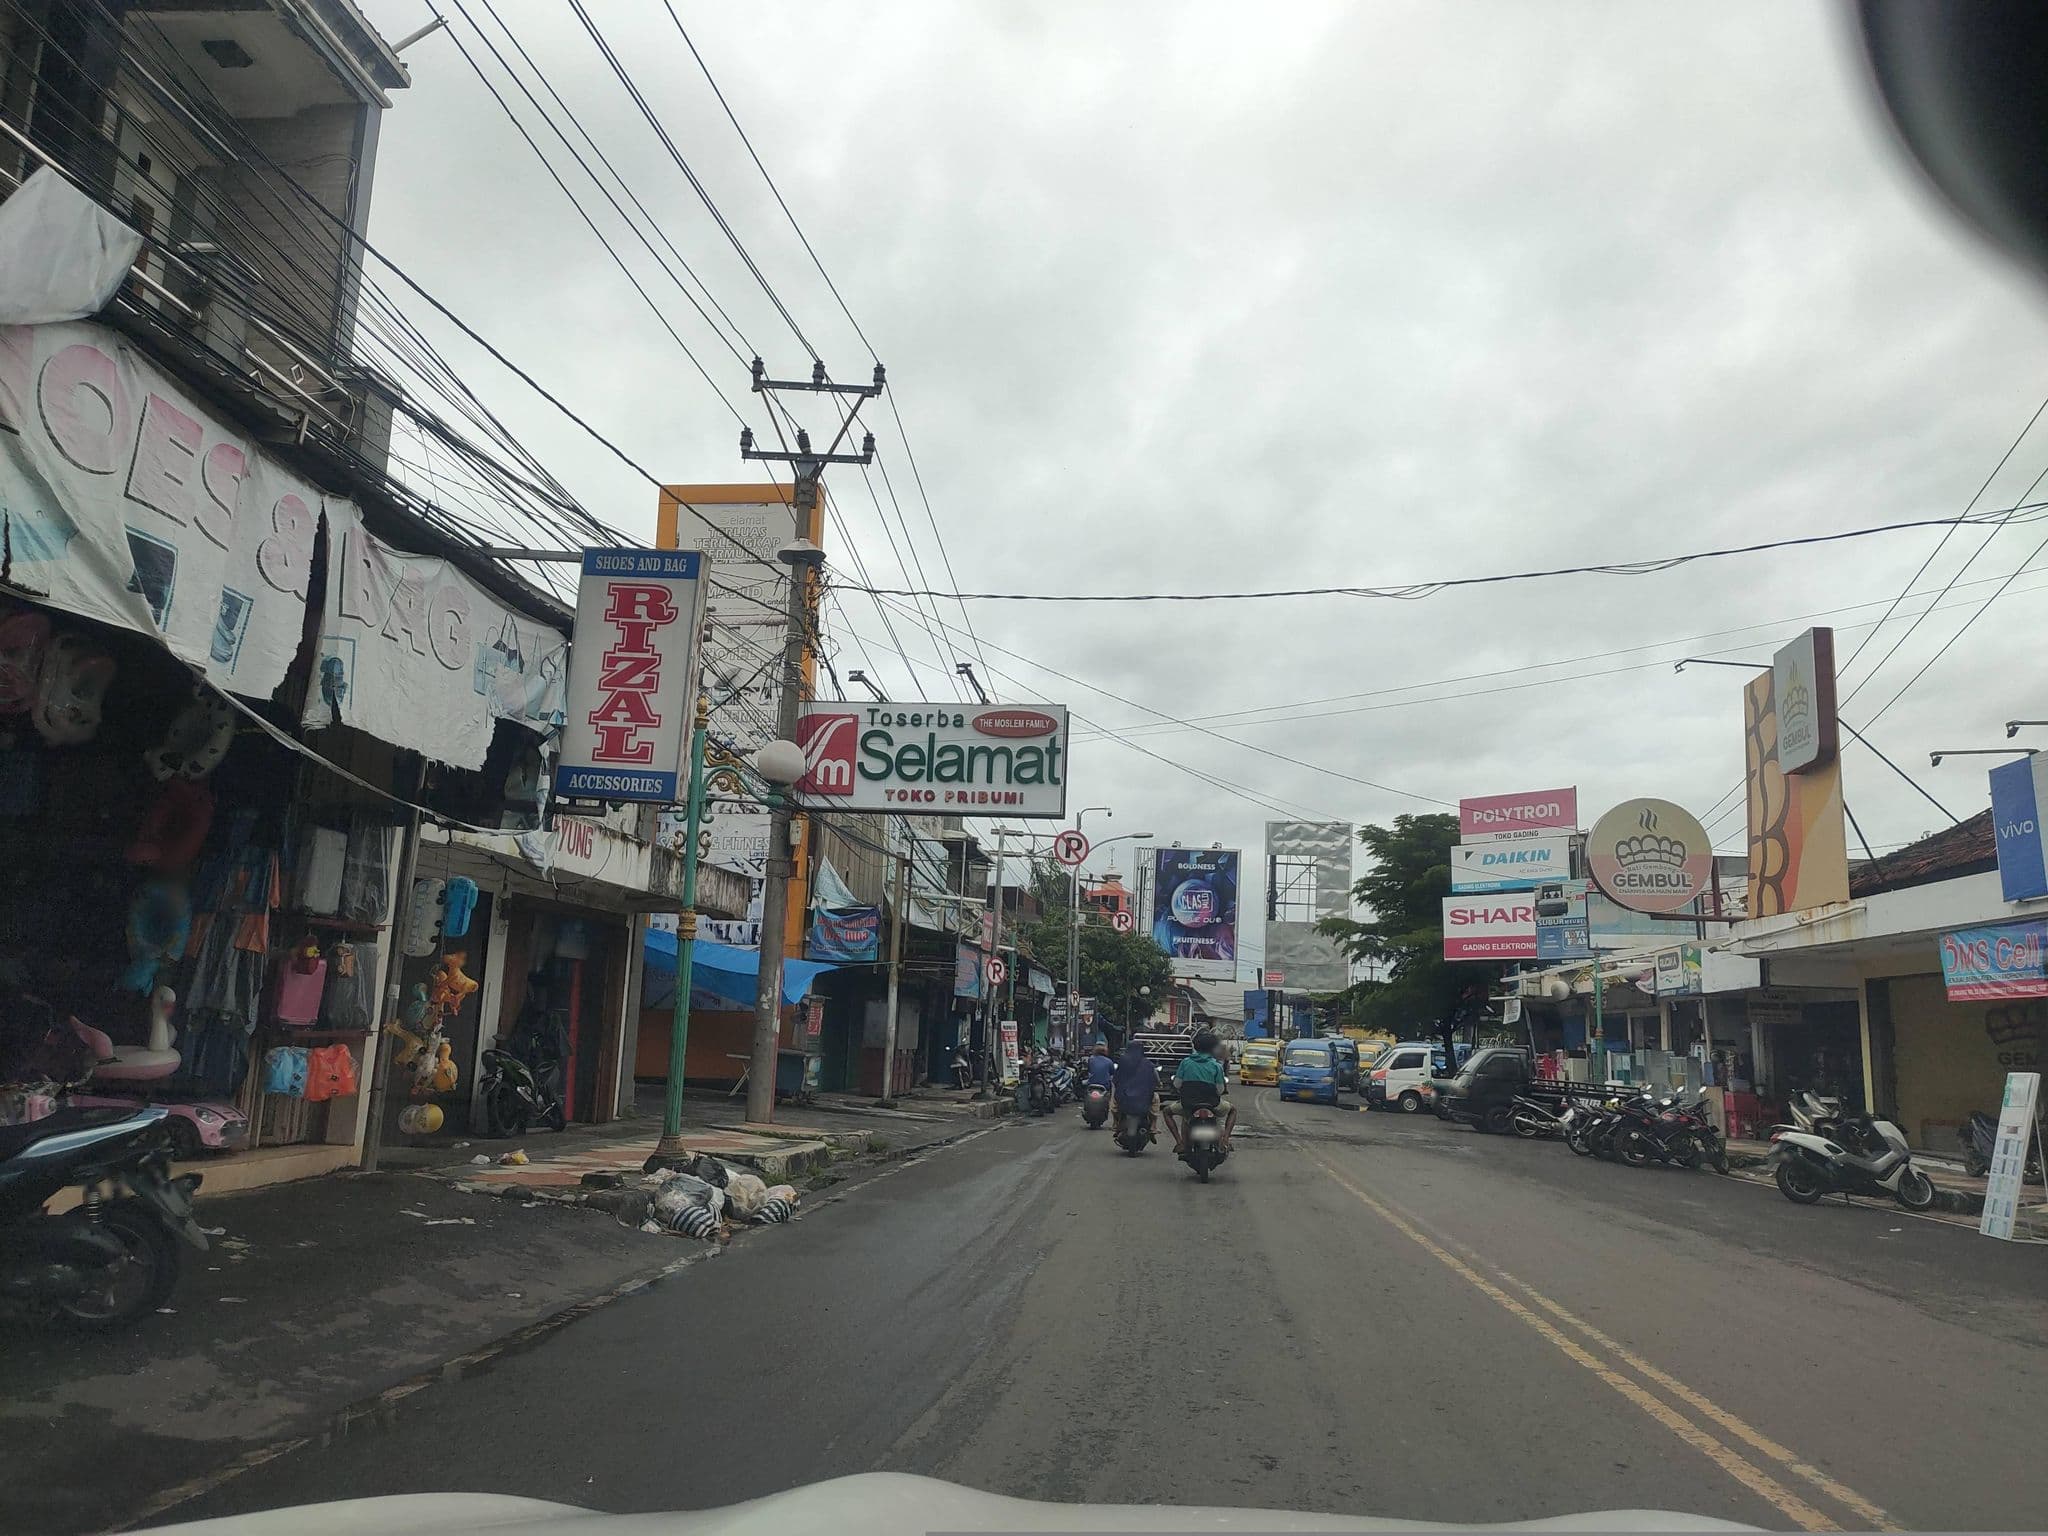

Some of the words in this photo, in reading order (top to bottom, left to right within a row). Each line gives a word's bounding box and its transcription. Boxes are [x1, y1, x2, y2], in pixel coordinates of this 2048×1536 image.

[596, 556, 634, 570] SHOES
[637, 558, 660, 571] AND
[664, 559, 687, 573] BAG
[589, 582, 678, 764] RIZAL
[867, 708, 964, 728] Toserba
[980, 719, 994, 728] THE
[995, 719, 1024, 728] MOSLEM
[1025, 719, 1050, 729] FAMILY
[857, 729, 1062, 785] Selamat
[569, 774, 662, 793] ACCESSORIES
[885, 789, 936, 802] TOKO
[945, 790, 1024, 805] PRIBUMI
[1473, 803, 1560, 824] POLYTRON
[1495, 833, 1512, 841] TOKO
[1513, 831, 1539, 839] GADING
[2001, 820, 2034, 839] vivo
[1482, 849, 1552, 865] DAIKIN
[1177, 863, 1216, 871] BOLDNESS
[1613, 873, 1693, 888] GEMBUL
[1450, 906, 1536, 926] SHAR
[1564, 929, 1588, 938] ROYA
[1462, 943, 1491, 951] GADING
[1995, 933, 2040, 971] Cell
